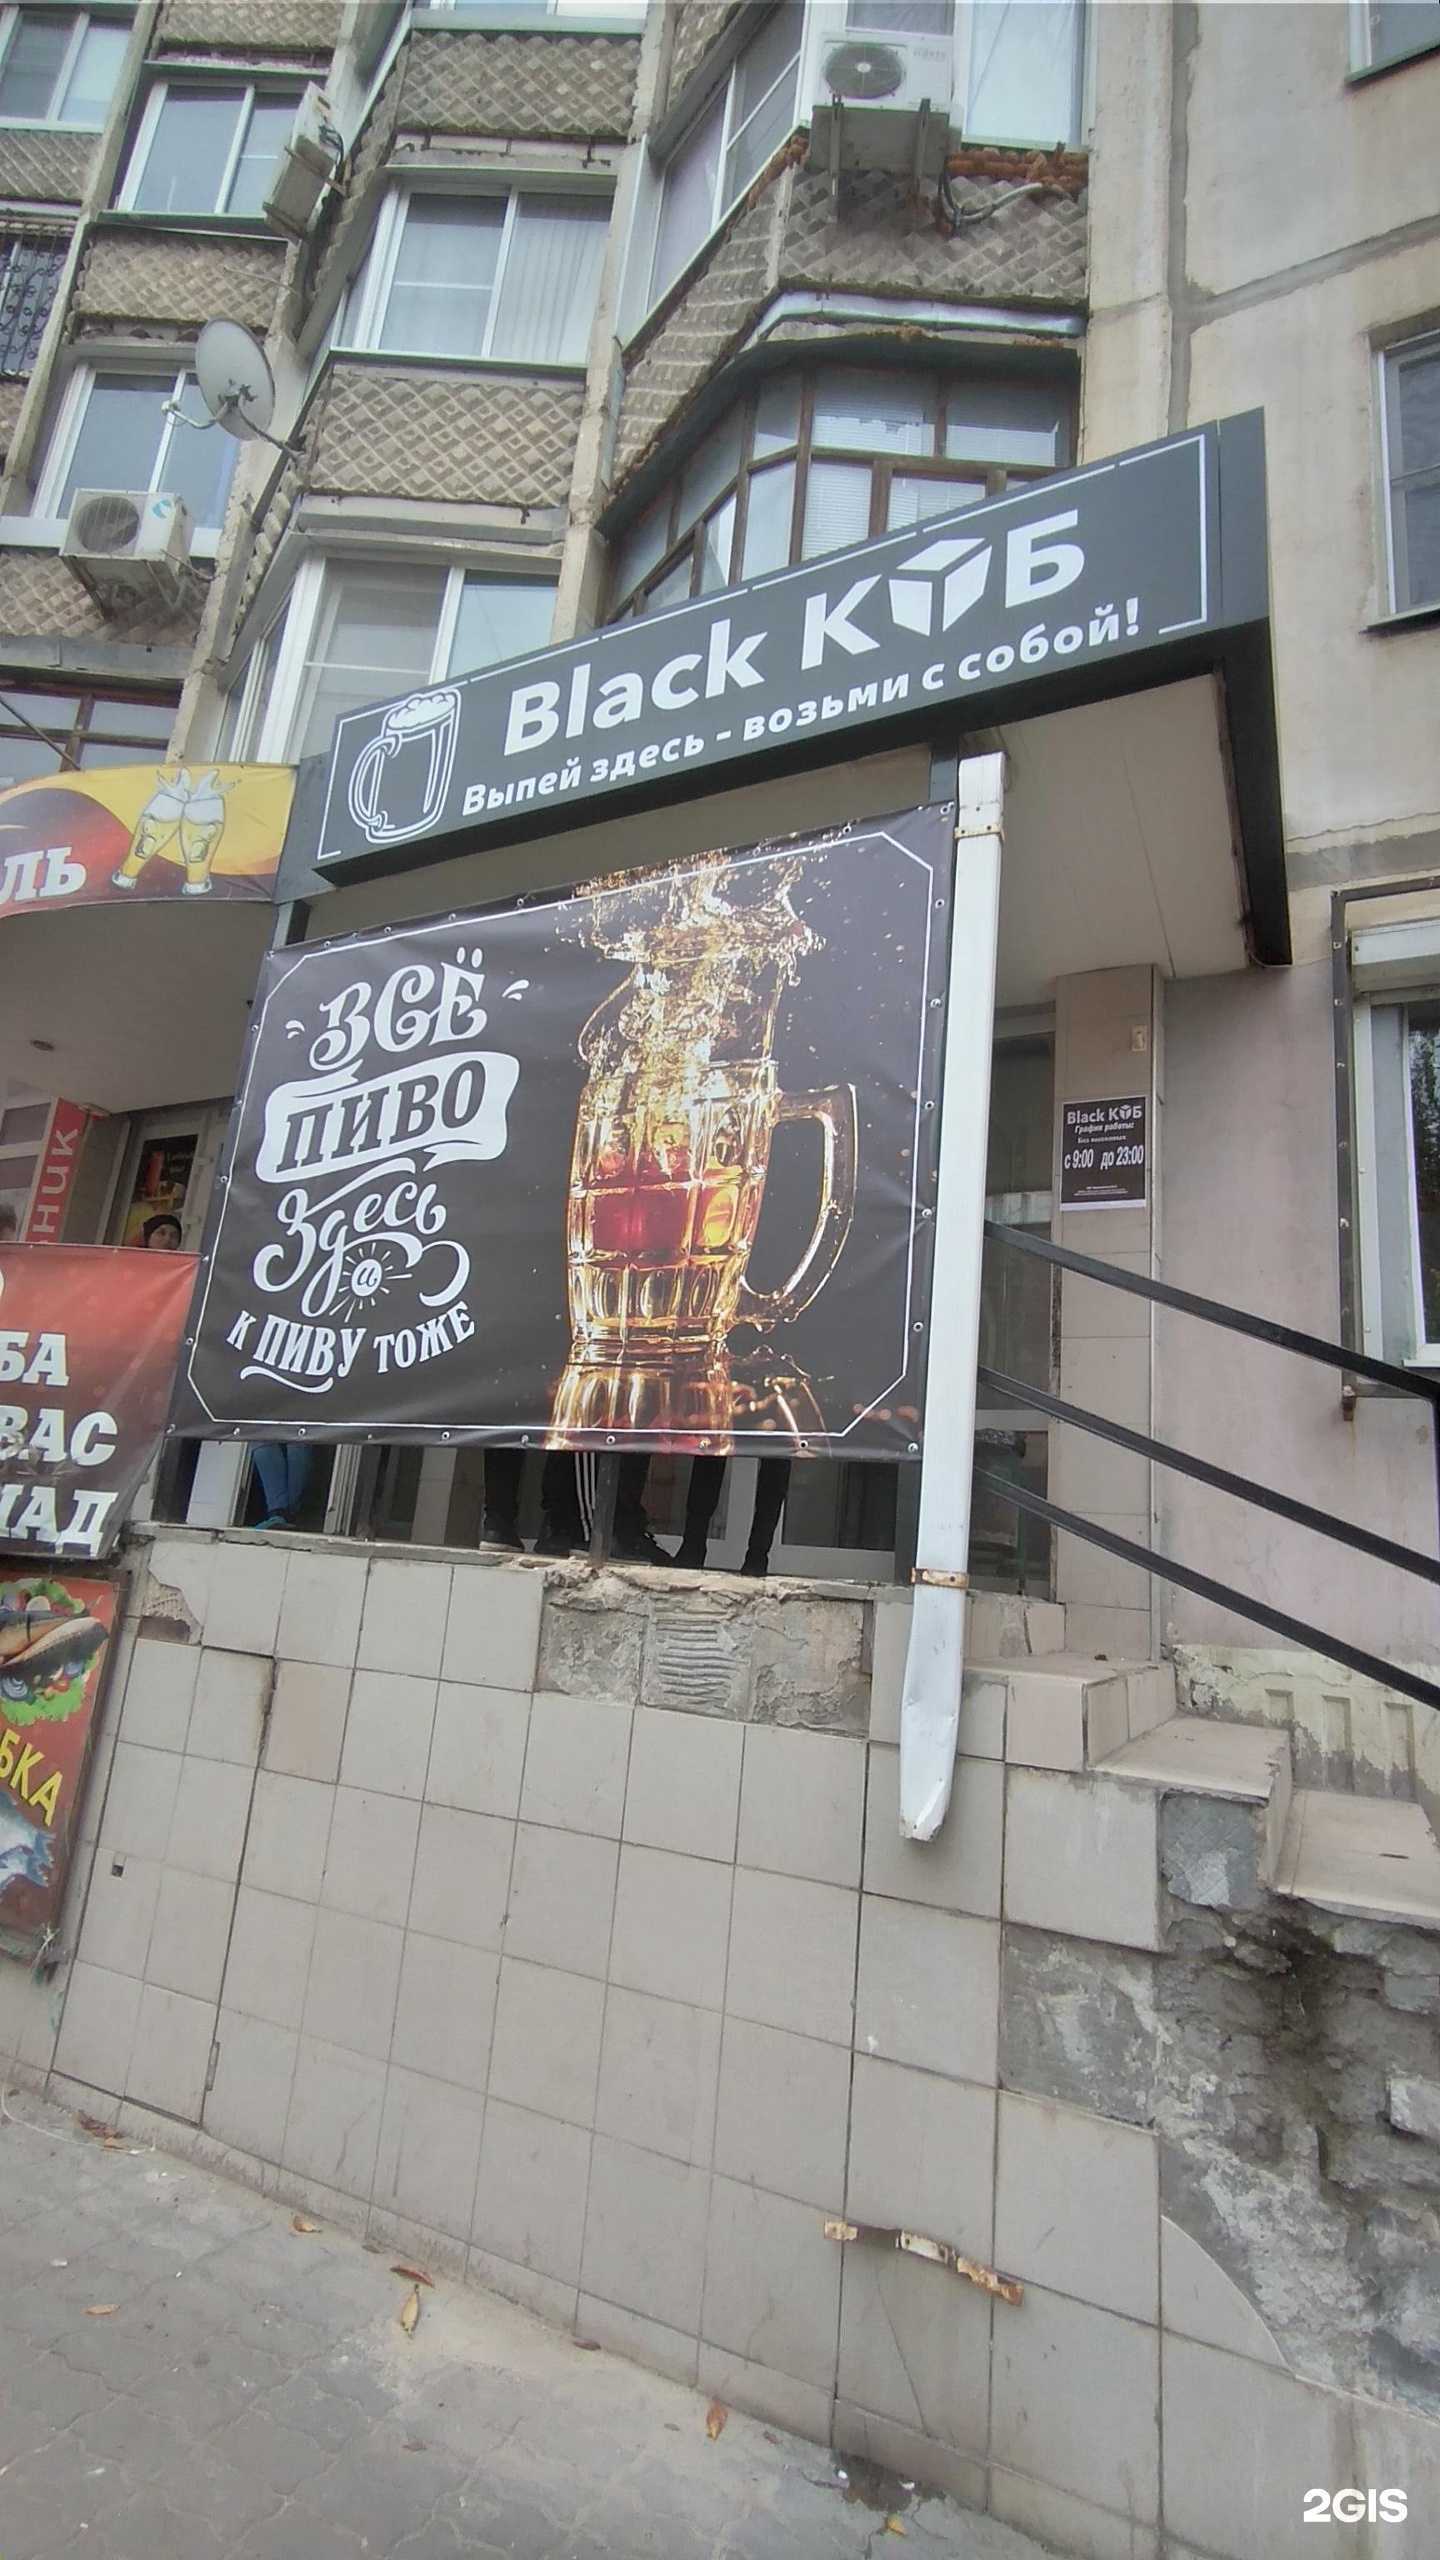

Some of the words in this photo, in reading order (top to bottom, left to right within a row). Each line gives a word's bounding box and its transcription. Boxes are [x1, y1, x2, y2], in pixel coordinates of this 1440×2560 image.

[462, 756, 581, 816] Выпей
[589, 736, 705, 783] здесь
[743, 673, 910, 742] возьми
[922, 663, 945, 691] с
[958, 597, 1140, 681] собой!
[503, 618, 768, 756] Black
[276, 1059, 488, 1173] ПИВО
[1067, 1108, 1105, 1125] Black
[1072, 1148, 1094, 1169] 9:00
[1100, 1151, 1114, 1170] до
[1115, 1144, 1144, 1166] 23:00
[252, 1313, 367, 1378] ПИВУ
[373, 1300, 476, 1374] ТОЖЕ
